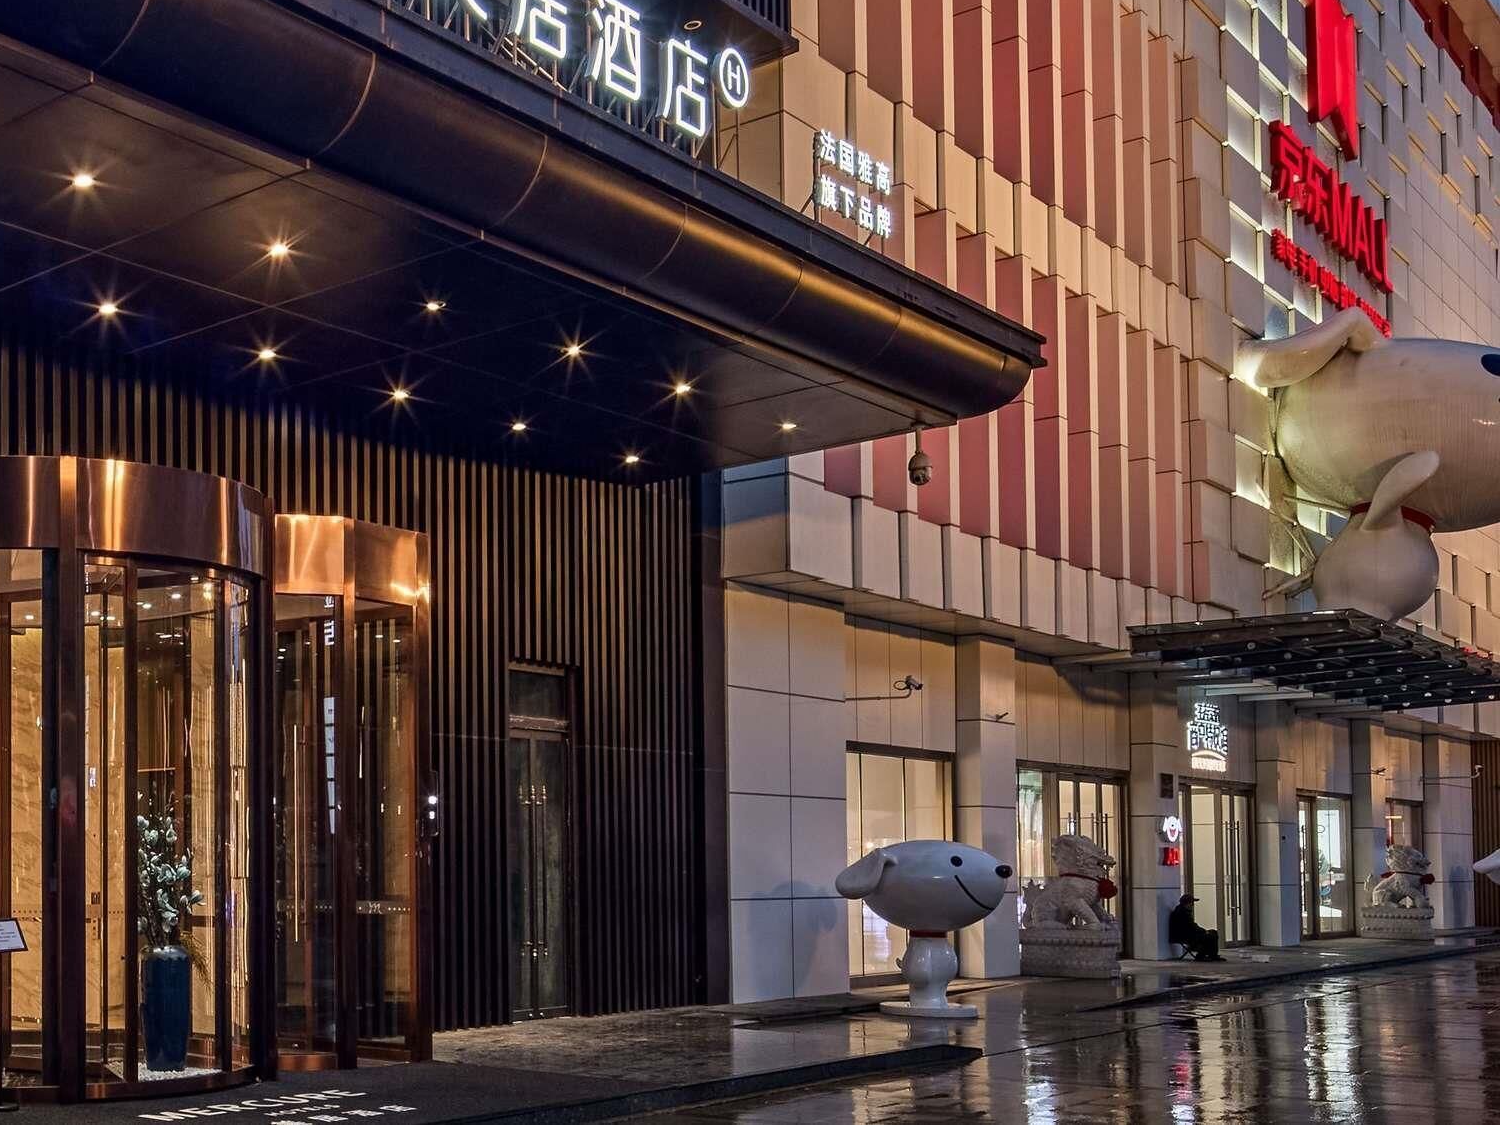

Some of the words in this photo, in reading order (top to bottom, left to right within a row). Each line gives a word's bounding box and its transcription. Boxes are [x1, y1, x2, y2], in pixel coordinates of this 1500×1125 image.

[819, 128, 892, 195] 法国雅高
[819, 174, 893, 239] 旗下品牌
[138, 1089, 367, 1122] MERCURE
